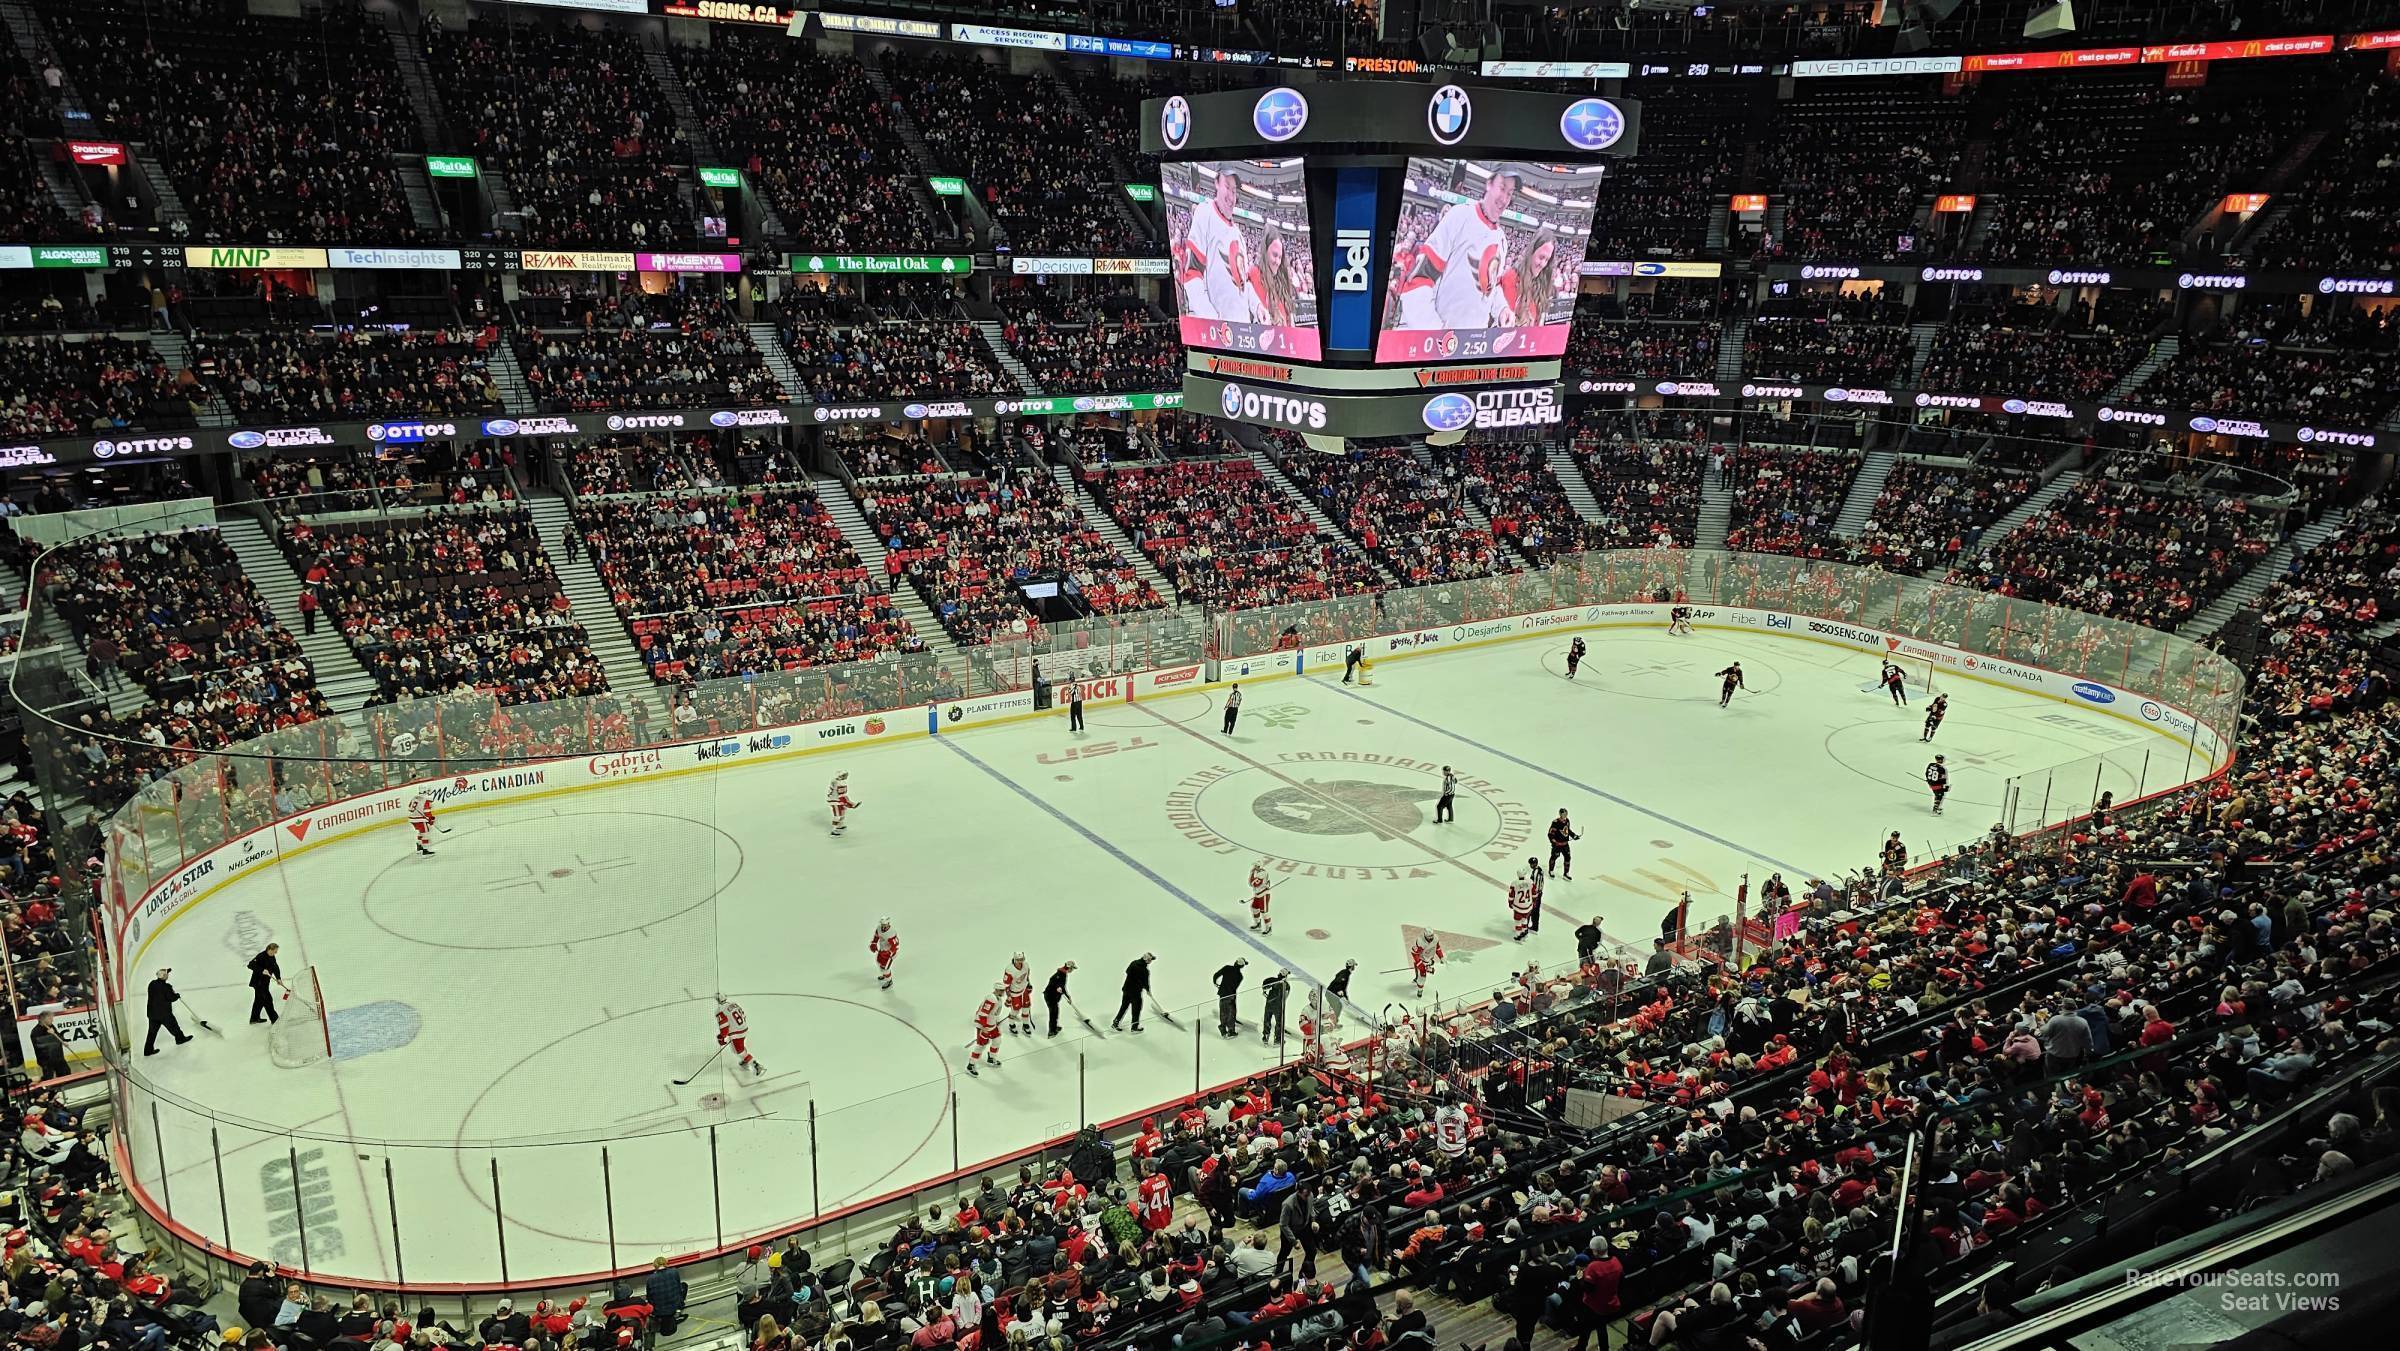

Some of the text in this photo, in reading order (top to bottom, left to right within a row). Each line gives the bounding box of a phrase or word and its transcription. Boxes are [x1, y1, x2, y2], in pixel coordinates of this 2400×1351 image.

[698, 1, 777, 23] SIGNS.CA
[1013, 32, 1049, 41] RIGGING
[1797, 61, 1957, 75] LIVENATION.com
[455, 162, 472, 172] Oak
[40, 250, 101, 261] ALGONQUIN
[112, 248, 130, 256] 319
[160, 248, 180, 256] 320
[211, 249, 270, 267] MNP
[346, 251, 446, 267] TechInsights
[464, 251, 481, 259] 320
[503, 251, 518, 260] 321
[115, 259, 132, 267] 219
[162, 259, 181, 267] 220
[465, 261, 482, 269] 220
[504, 261, 519, 270] 221
[524, 253, 631, 269] RE/MAX Hallmark
[581, 262, 632, 271] Realty Group
[667, 256, 723, 266] MAGENTA
[836, 256, 929, 273] The Royal Oak
[1031, 258, 1087, 274] Decisive
[1096, 259, 1168, 273] RE/MAX Hallmark
[1335, 229, 1370, 291] Bell
[1813, 267, 1860, 278] OTTO'S
[1935, 269, 1983, 281] OTTO'S
[2062, 271, 2110, 284] OTTO'S
[2193, 276, 2246, 289] OTTO'S
[2335, 280, 2394, 294] OTTO'S
[1237, 335, 1256, 349] 2:50
[1424, 338, 1432, 353] 0
[1463, 341, 1487, 356] 2:50
[1519, 334, 1526, 349] 1
[1592, 382, 1636, 392] OTTO'S
[1755, 386, 1803, 398] OTTO'S
[1008, 400, 1053, 412] OTTO'S
[1476, 388, 1555, 411] OTTO'S
[1930, 395, 1981, 409] OTTO'S
[830, 407, 881, 420] OTTO'S
[1244, 392, 1327, 428] OTTO'S
[1475, 404, 1563, 429] SUBARU
[624, 415, 684, 429] OTTO'S
[2113, 410, 2166, 426] OTTO'S
[386, 424, 456, 439] OTTO'S
[115, 437, 193, 455] OTTO'S
[2315, 431, 2375, 448] OTTO'S
[1535, 613, 1579, 628] FairSquare
[1601, 608, 1655, 619] Pathways Alliance
[1731, 613, 1757, 626] Fibe
[1766, 613, 1792, 630] Bell
[1467, 622, 1512, 639] Desjardins
[1390, 633, 1439, 651] Booster Juice
[1315, 650, 1337, 664] Fibe
[1903, 644, 1958, 667] CANADIAN TIRE
[1979, 661, 2043, 684] AIR CANADA
[965, 697, 1032, 715] PLANET FITNESS
[818, 722, 856, 739] voilà
[588, 748, 661, 776] Gabriel
[612, 763, 663, 778] PIZZA
[432, 770, 545, 804] Molson CANADIAN
[1277, 751, 1448, 777] CANADIAN
[1497, 801, 1534, 852] CENTRE
[316, 804, 375, 831] CANADIAN
[374, 797, 402, 817] TIRE
[228, 847, 273, 873] NHLSHOP.CA
[146, 859, 215, 919] LONE STAR
[1517, 889, 1531, 904] 24
[159, 885, 199, 917] TEXAS GRILL
[57, 1018, 89, 1030] RIDEAU
[1444, 1125, 1457, 1145] 5
[1150, 1187, 1171, 1213] 44
[918, 1280, 935, 1304] H
